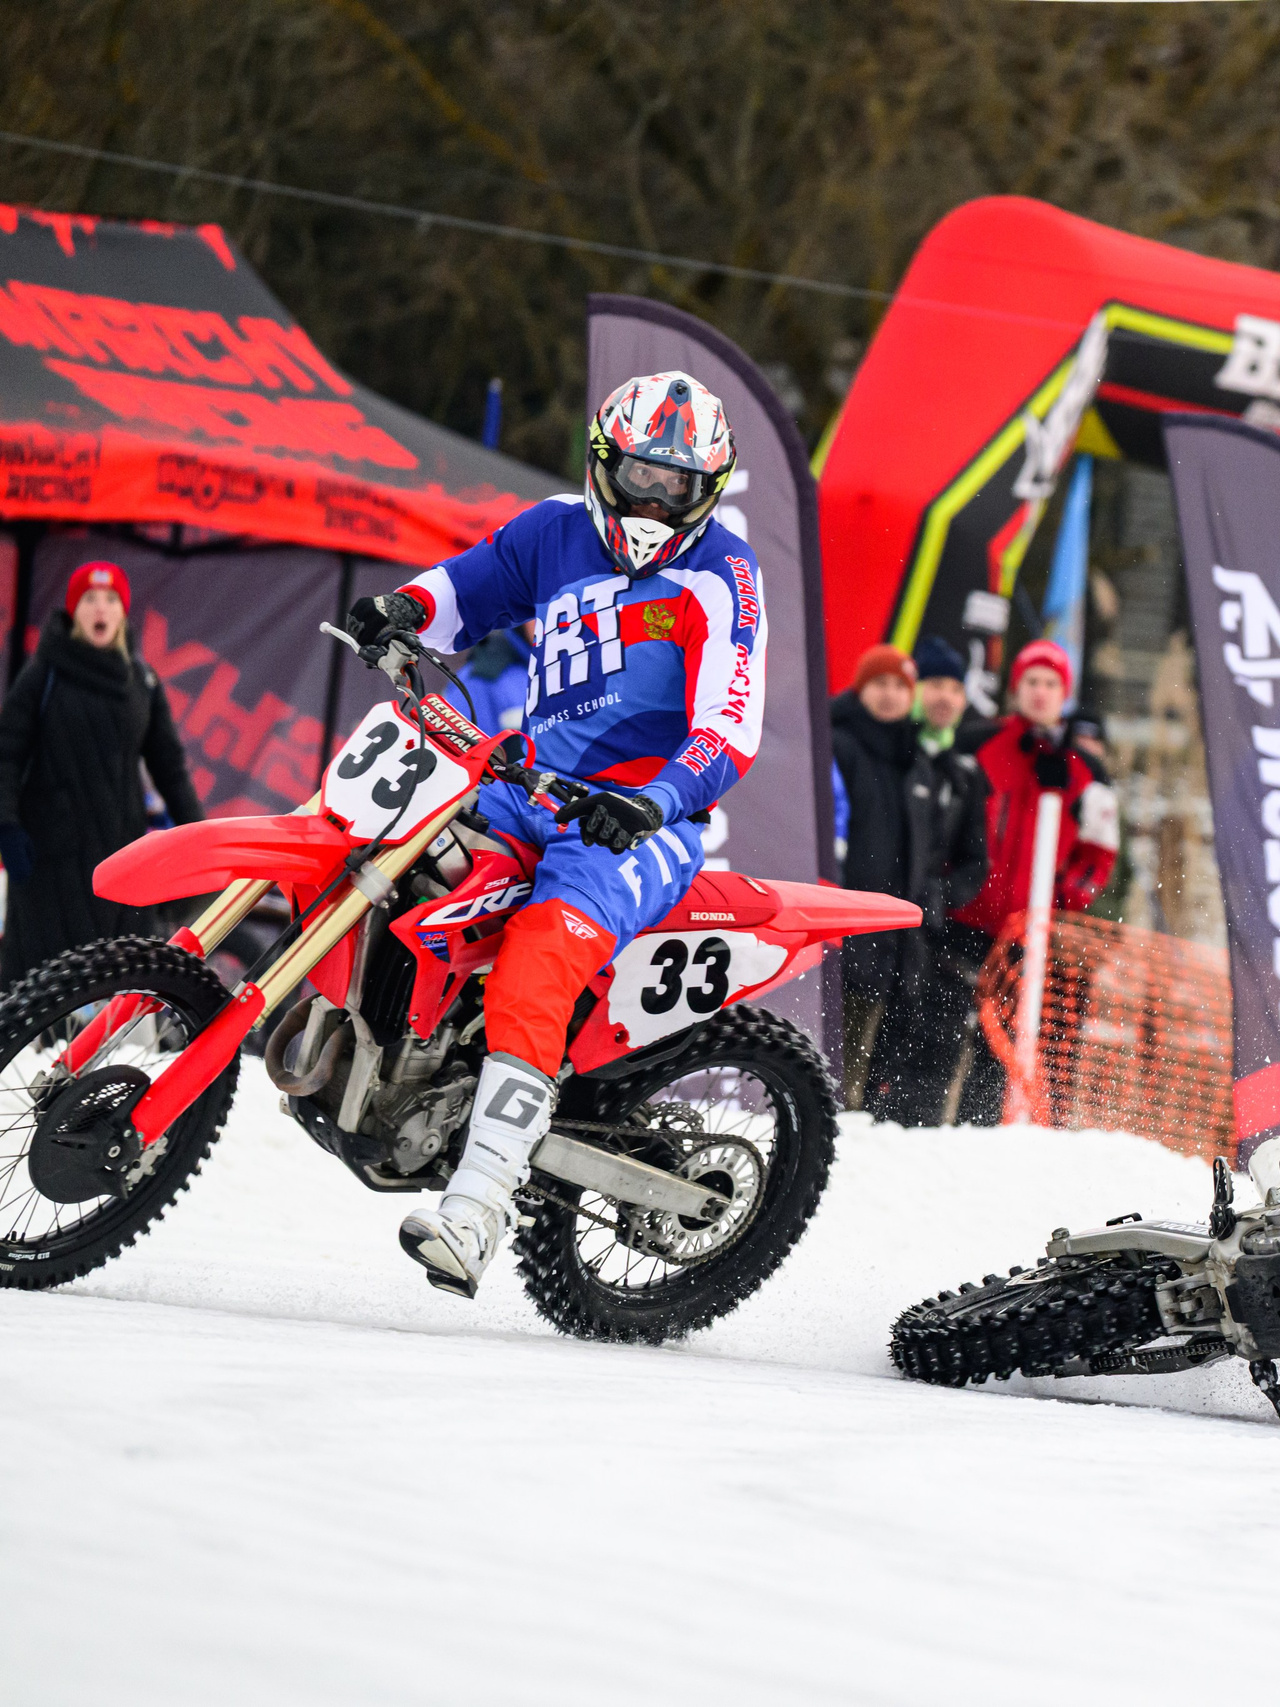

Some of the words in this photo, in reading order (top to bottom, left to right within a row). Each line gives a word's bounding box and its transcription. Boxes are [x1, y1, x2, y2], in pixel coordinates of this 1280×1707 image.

[725, 555, 760, 636] SHARK
[576, 691, 622, 716] SCHOOL
[337, 721, 438, 810] 33
[675, 727, 728, 777] TEAM
[420, 882, 533, 926] CRF
[690, 911, 736, 922] HONDA
[640, 937, 732, 1015] 33
[484, 1077, 548, 1130] G
